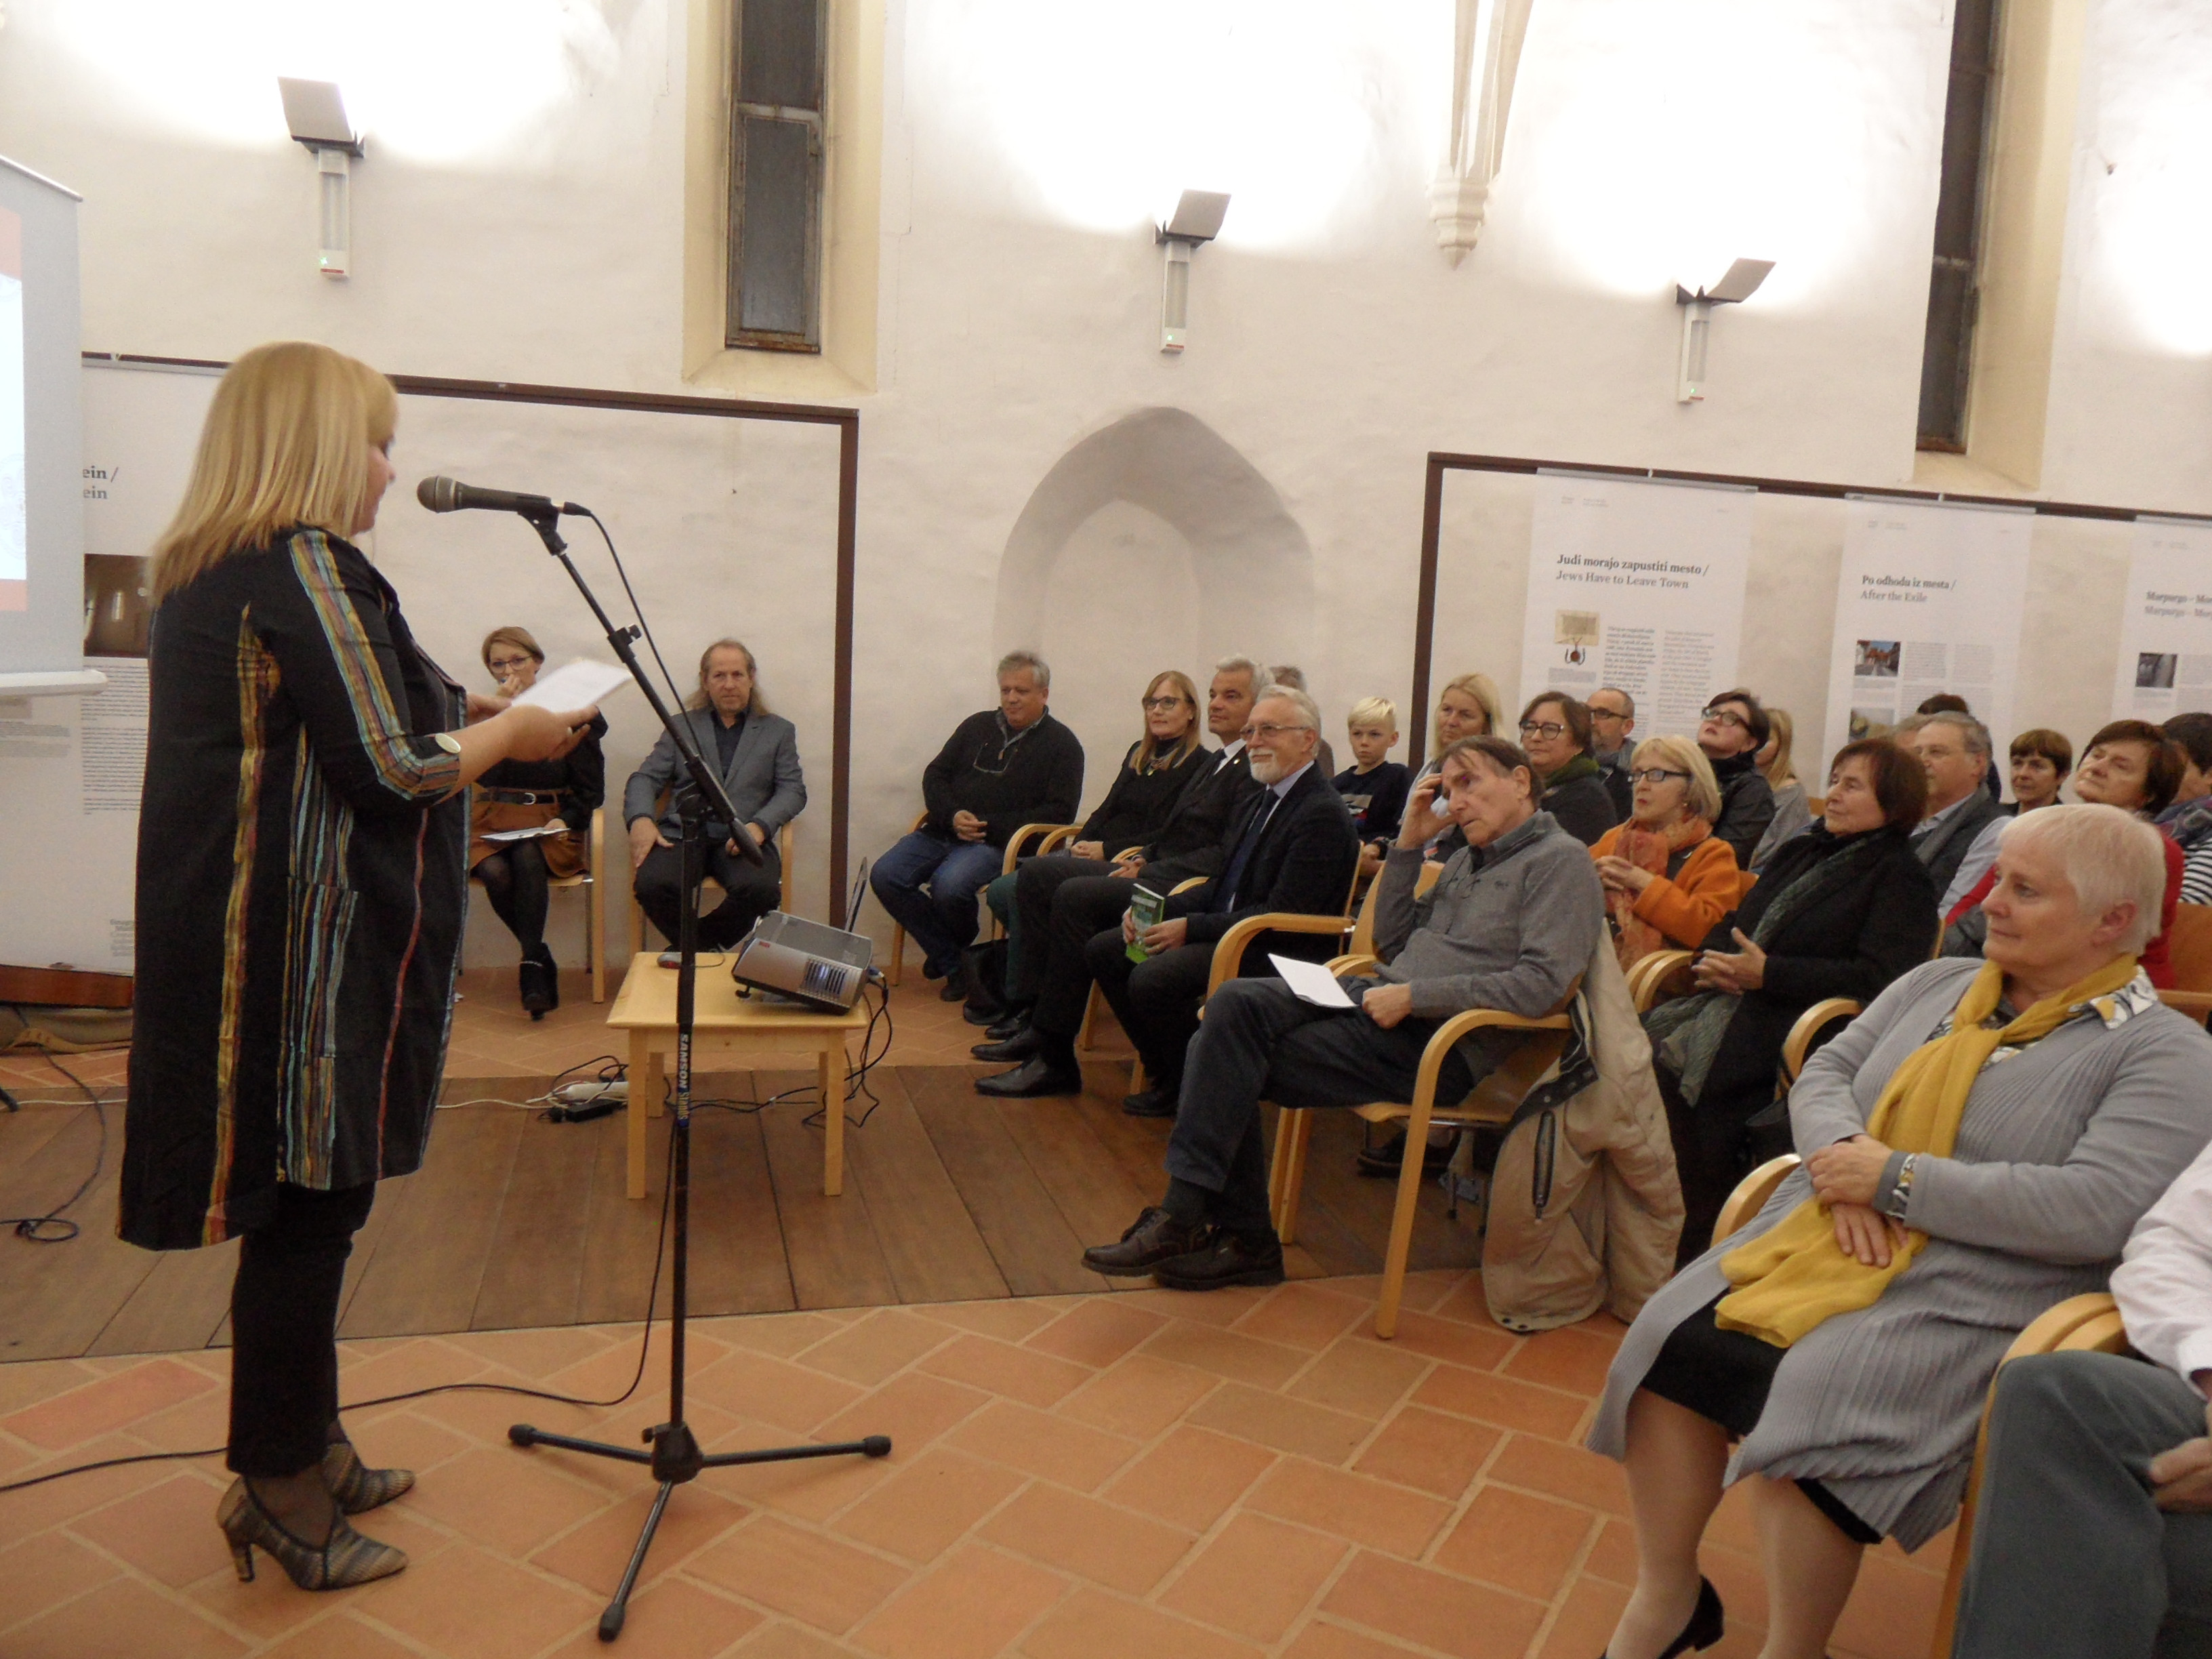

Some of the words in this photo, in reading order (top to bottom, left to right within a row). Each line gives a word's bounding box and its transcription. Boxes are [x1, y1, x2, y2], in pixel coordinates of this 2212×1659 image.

[1557, 554, 1582, 565] Judi
[1583, 557, 1620, 570] morajo
[1621, 560, 1668, 572] zapustiti
[1670, 565, 1702, 575] mesto
[1556, 571, 1583, 581] Jews
[1585, 572, 1611, 583] Have
[1613, 575, 1623, 585] to
[1626, 575, 1657, 587] Leave
[1660, 577, 1689, 589] Town
[1862, 575, 1875, 586] Po
[1876, 575, 1910, 586] odhodu
[1923, 580, 1950, 589] mesta
[1860, 590, 1886, 600] After
[1887, 591, 1902, 600] the
[680, 1033, 689, 1089] SAMSON
